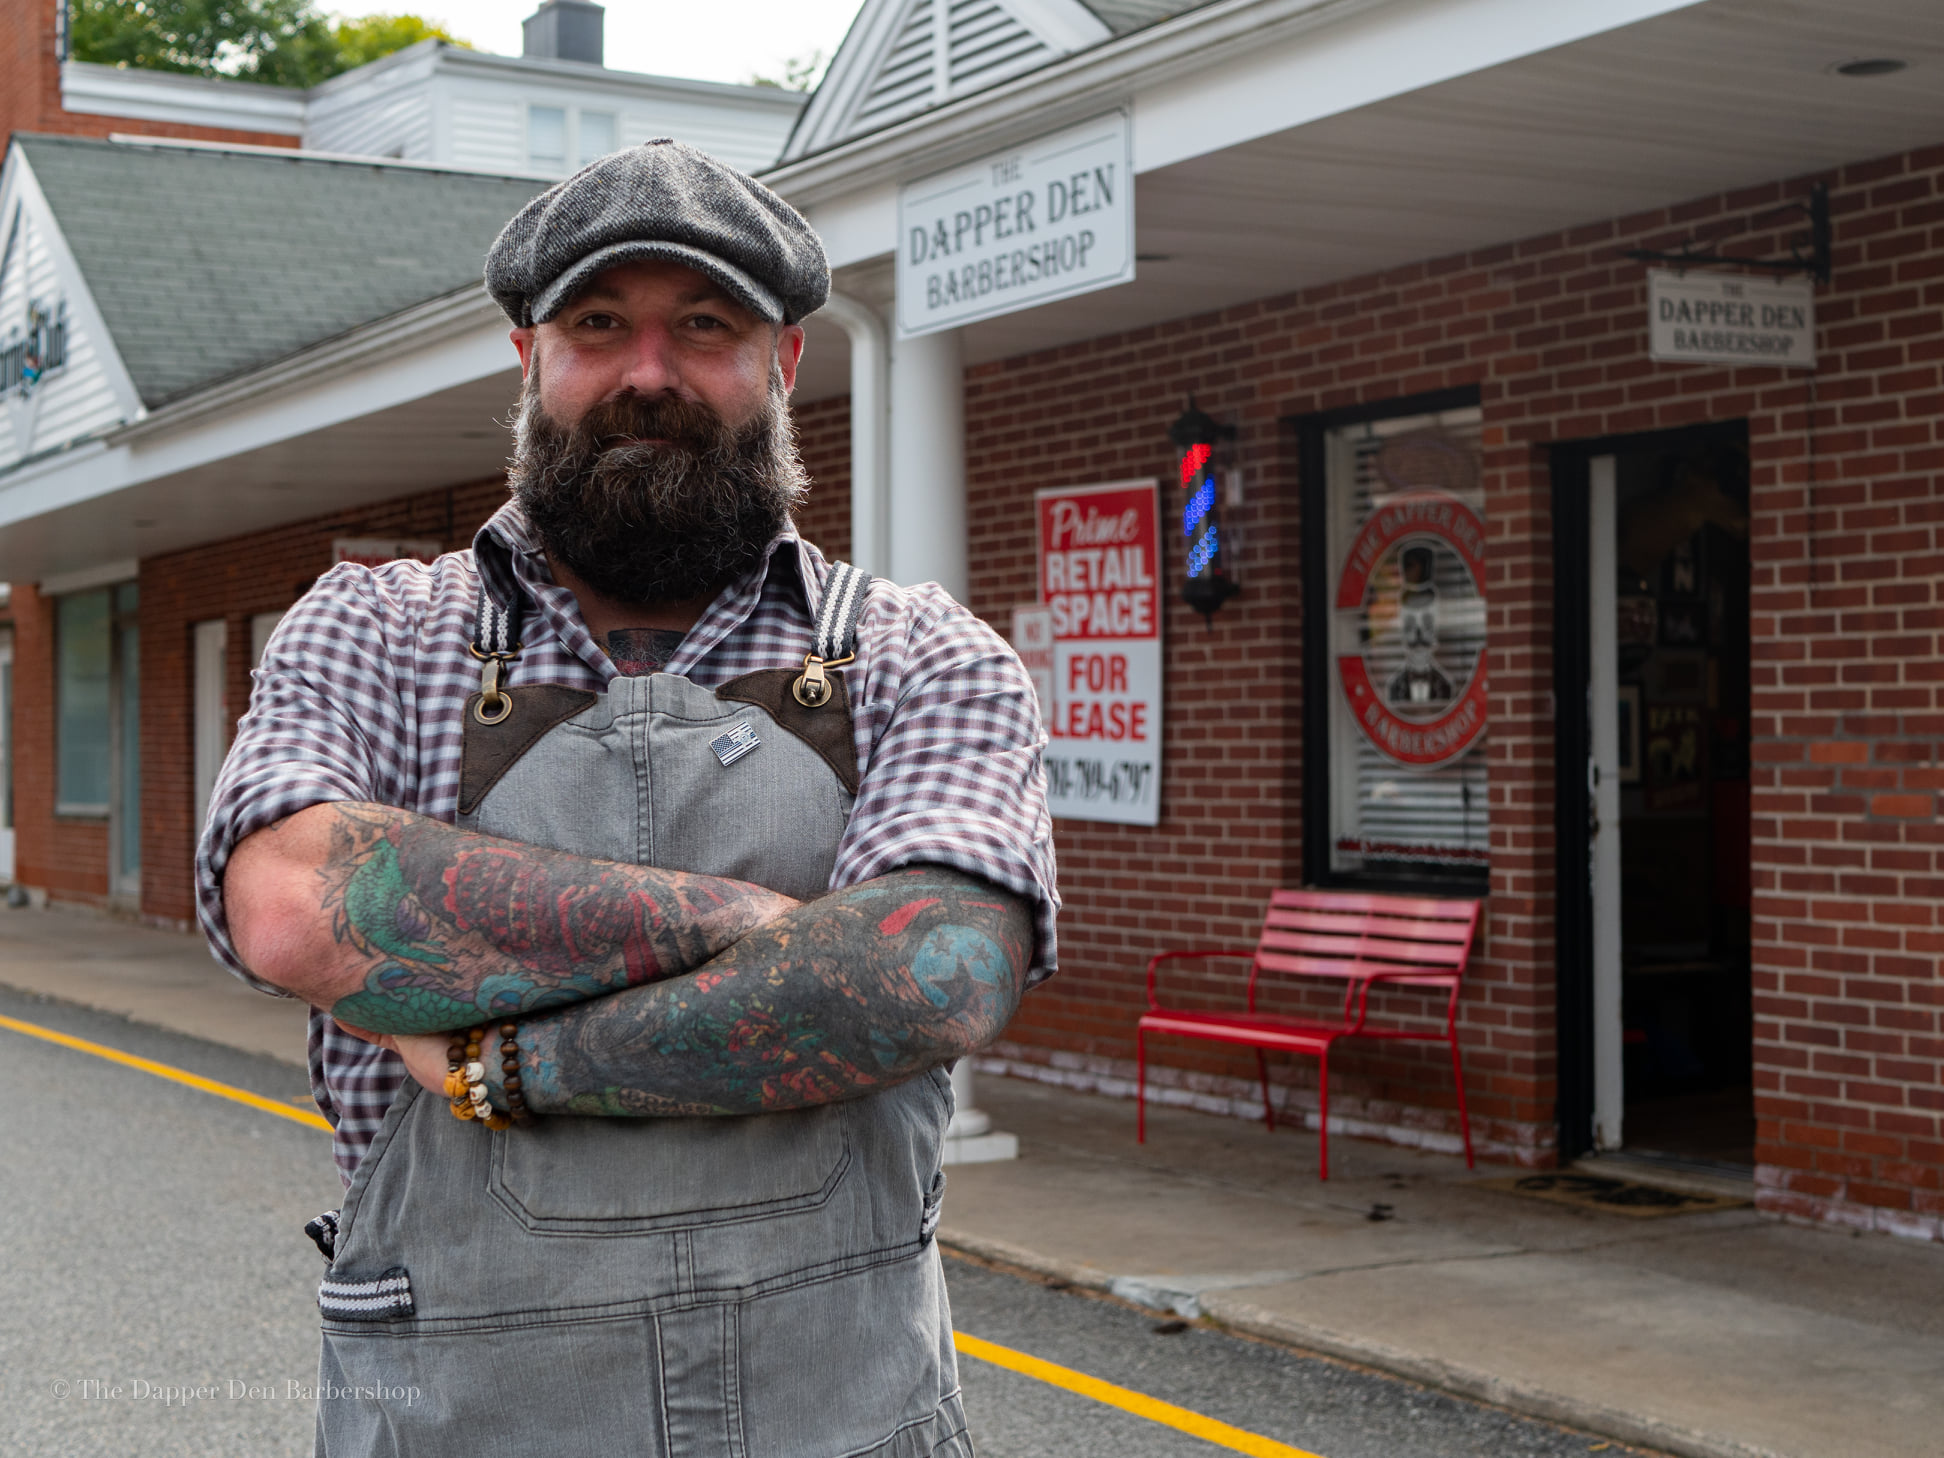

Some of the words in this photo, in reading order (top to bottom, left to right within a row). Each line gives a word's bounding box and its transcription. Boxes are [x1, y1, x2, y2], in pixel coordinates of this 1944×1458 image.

[990, 156, 1023, 187] THE
[909, 190, 1036, 266] DAPPER
[1046, 163, 1115, 224] DEN
[926, 229, 1096, 310] BARBERSHOP
[1659, 297, 1755, 328] DAPPER
[1761, 304, 1806, 330] DEN
[1673, 328, 1794, 356] BARBERSHOP
[1050, 500, 1139, 549] Prime
[1046, 546, 1152, 592] RETAIL
[1051, 591, 1150, 638] SPACE
[1068, 653, 1128, 693] FOR
[1051, 701, 1148, 741] LEASE
[1364, 699, 1477, 755] BARBERSHOP
